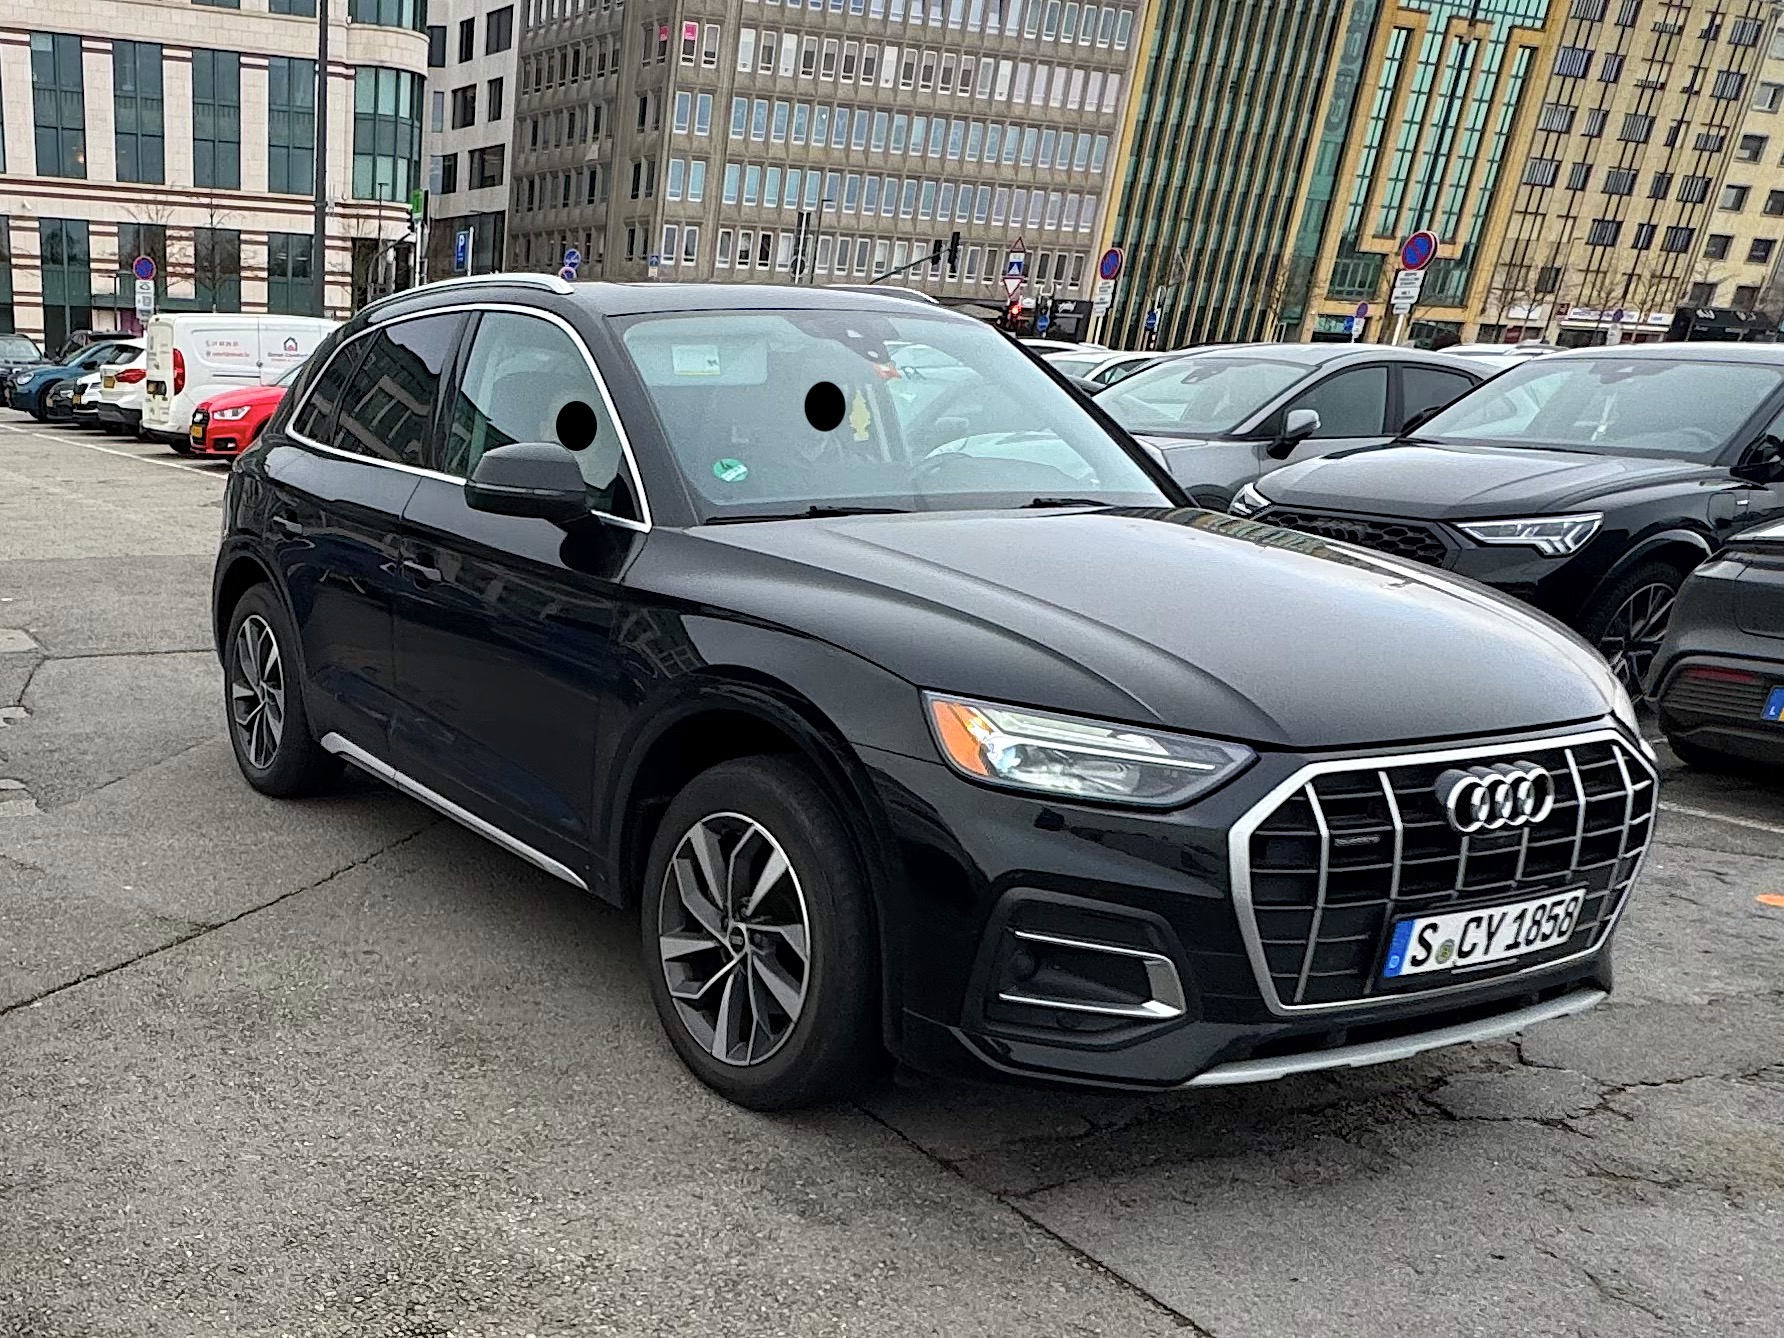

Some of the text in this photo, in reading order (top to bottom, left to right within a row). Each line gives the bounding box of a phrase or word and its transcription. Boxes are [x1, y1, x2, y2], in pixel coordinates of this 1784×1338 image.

[458, 234, 465, 252] P
[1769, 706, 1776, 716] L
[1410, 922, 1439, 967] S
